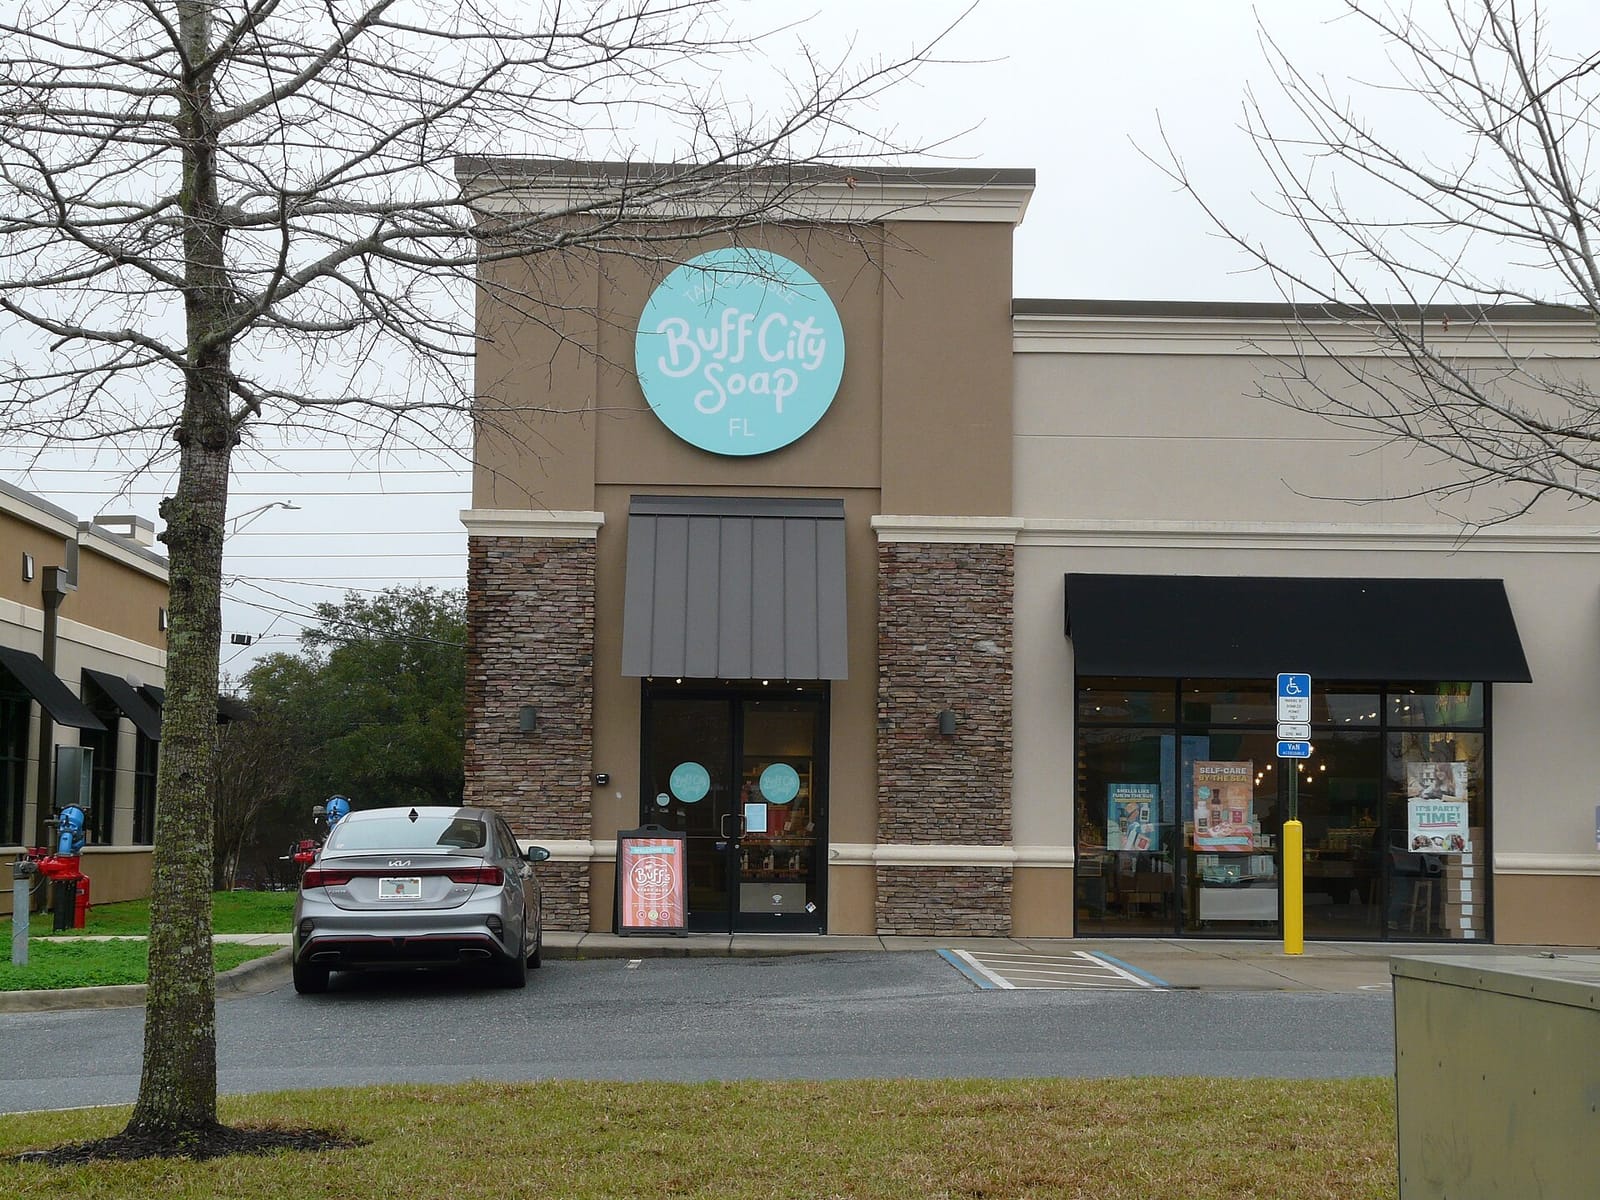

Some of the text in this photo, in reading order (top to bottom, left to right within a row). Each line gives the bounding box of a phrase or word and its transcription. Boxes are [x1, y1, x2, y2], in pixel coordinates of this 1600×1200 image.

[656, 307, 827, 378] Buff City
[694, 362, 799, 414] Soap
[728, 418, 755, 437] FL
[1287, 743, 1301, 751] VAN
[1416, 813, 1461, 823] TIME!
